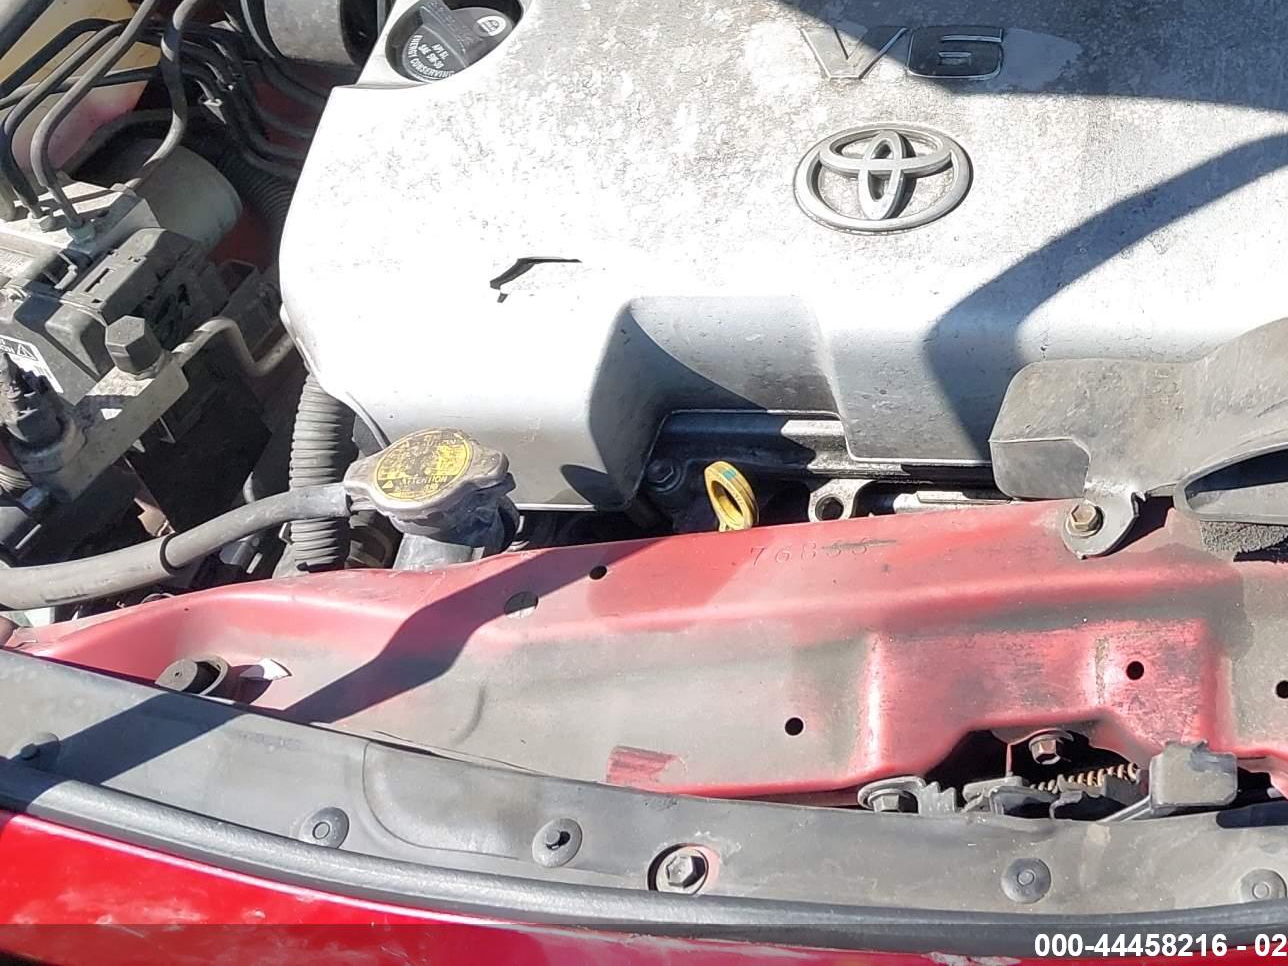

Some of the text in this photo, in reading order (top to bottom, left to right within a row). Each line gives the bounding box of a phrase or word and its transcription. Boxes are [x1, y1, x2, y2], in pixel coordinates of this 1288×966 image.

[407, 34, 424, 58] ENERGY
[418, 44, 445, 69] SAE 5W-30
[798, 24, 1005, 80] V6
